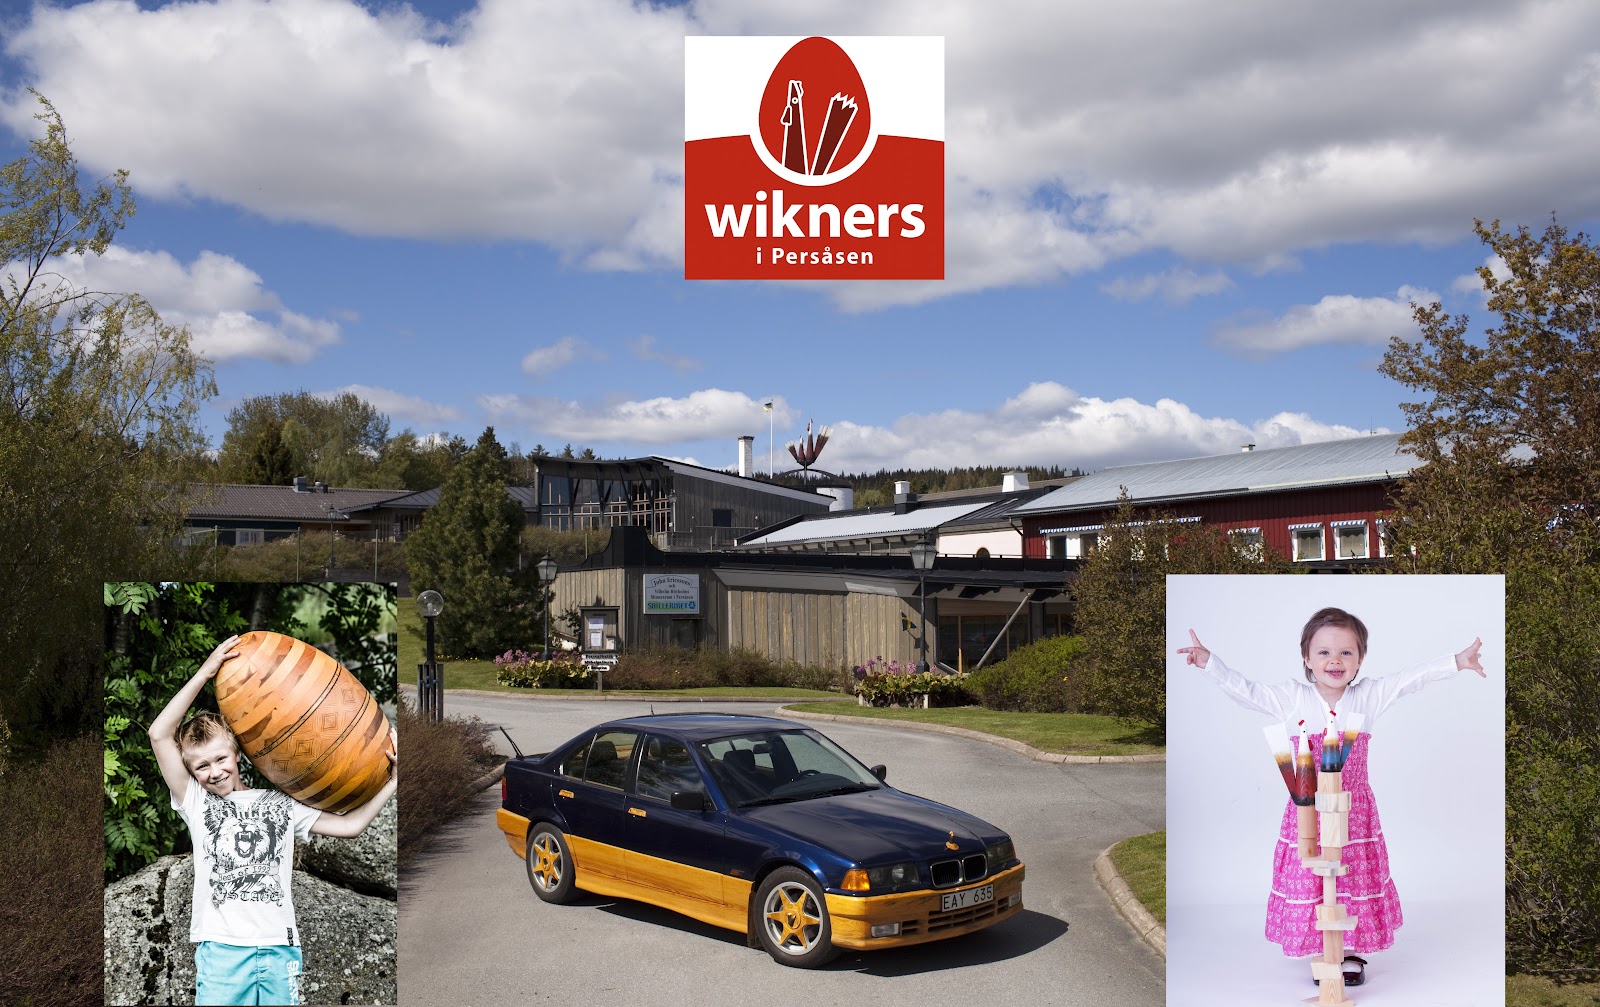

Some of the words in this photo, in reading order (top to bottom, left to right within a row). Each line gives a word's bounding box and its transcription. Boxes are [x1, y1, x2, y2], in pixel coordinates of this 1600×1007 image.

[237, 867, 249, 878] of
[252, 865, 271, 876] 1992
[943, 893, 966, 910] EAY
[973, 886, 993, 903] 635
